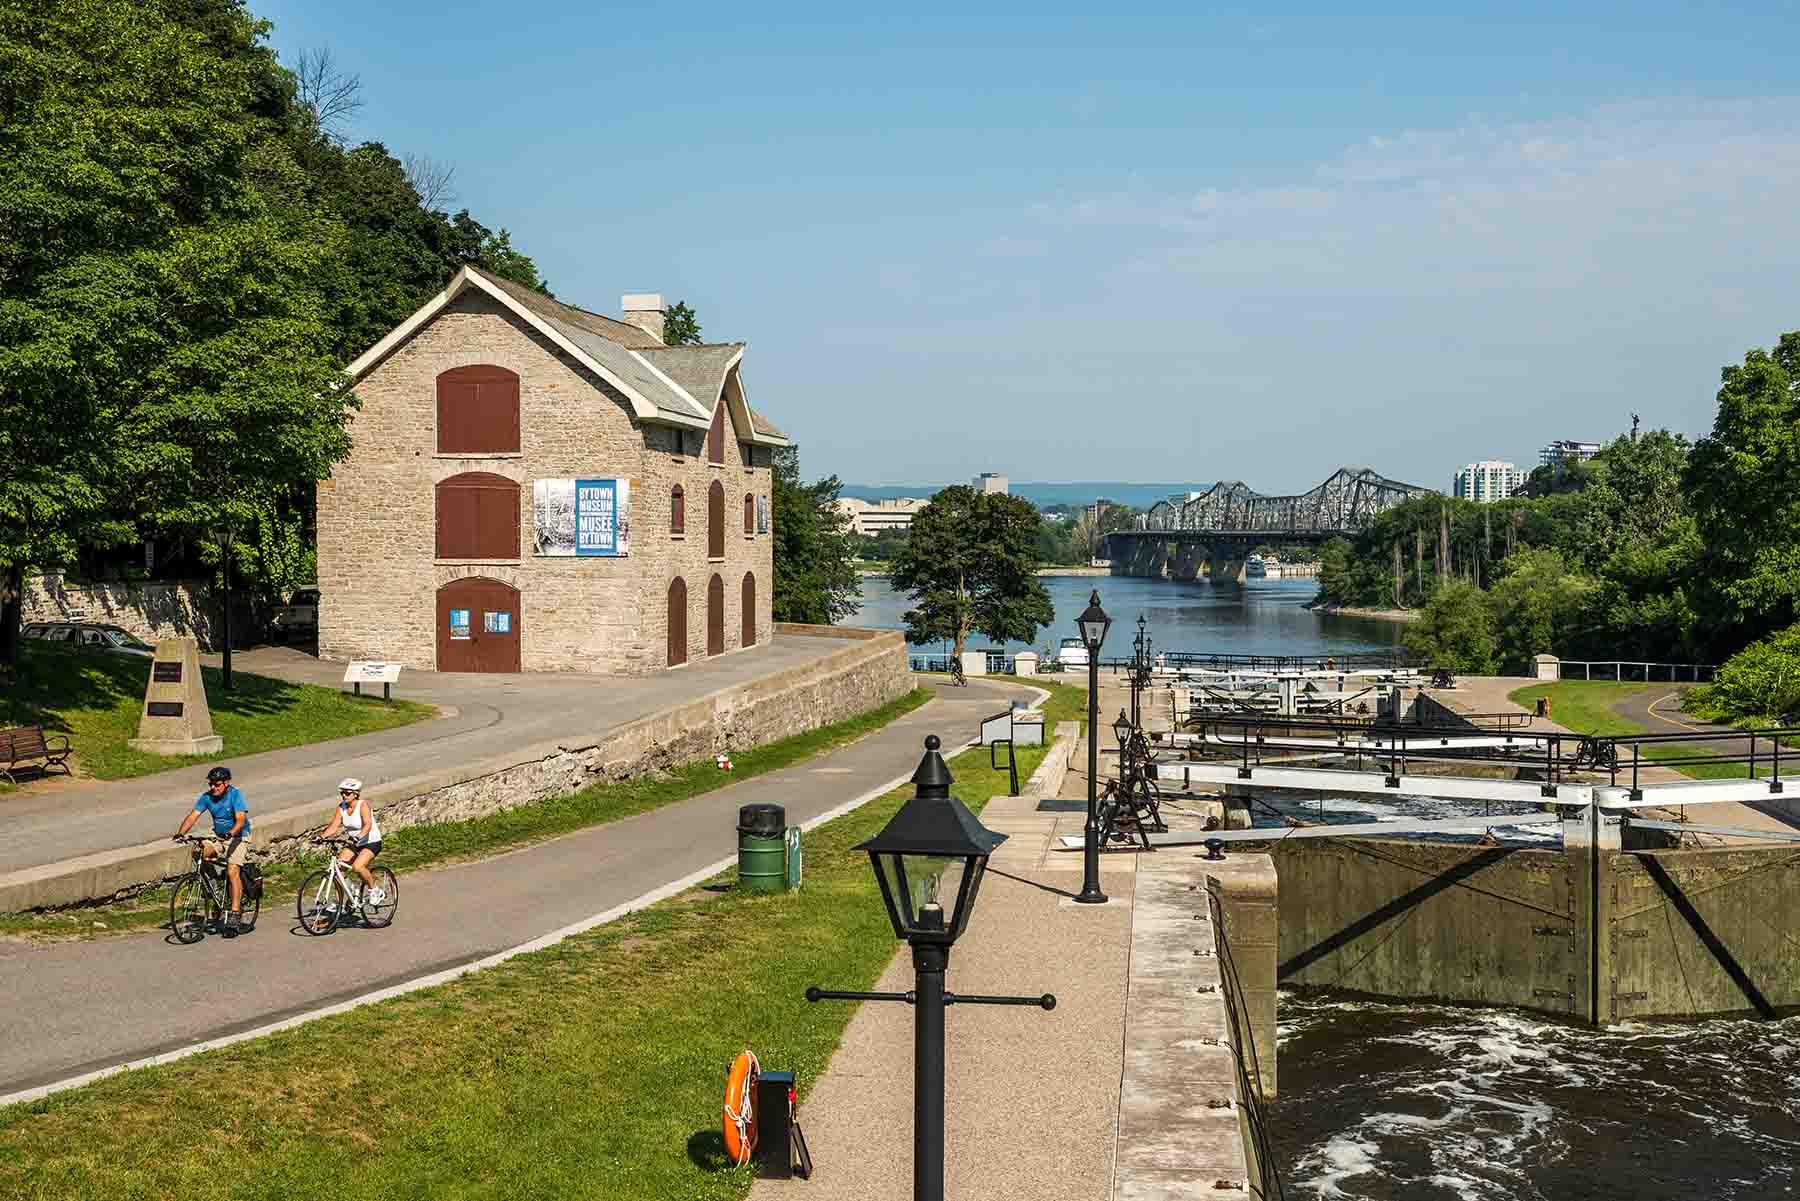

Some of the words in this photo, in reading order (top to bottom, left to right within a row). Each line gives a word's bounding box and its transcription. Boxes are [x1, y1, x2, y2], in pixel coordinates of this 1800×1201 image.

[579, 488, 613, 499] BYTOWN
[579, 499, 613, 512] MUSEUM
[579, 532, 613, 544] BYTOWN
